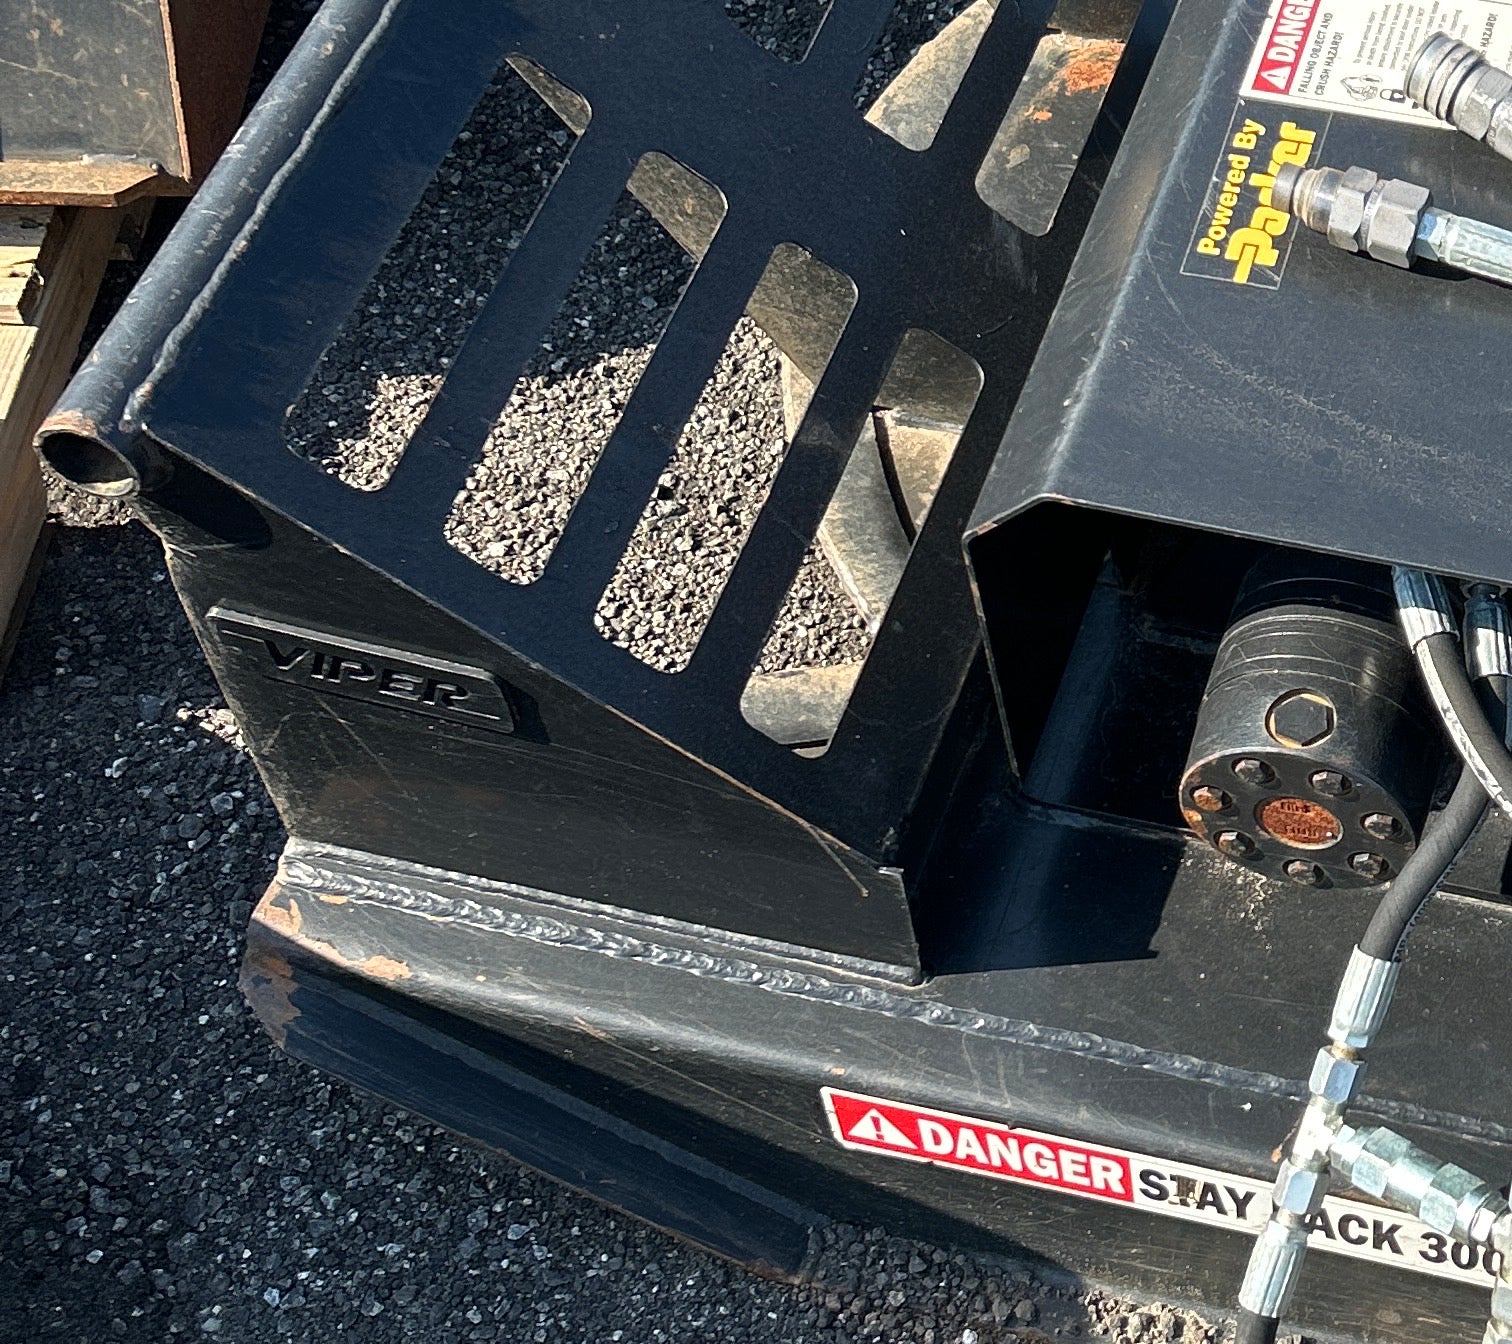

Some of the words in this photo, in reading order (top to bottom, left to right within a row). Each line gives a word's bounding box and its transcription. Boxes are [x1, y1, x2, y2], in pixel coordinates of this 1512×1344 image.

[1296, 59, 1317, 93] FALLING
[1308, 30, 1327, 59] OBJECT
[1319, 12, 1334, 29] AND
[1313, 68, 1331, 95] CRUSH
[1197, 154, 1251, 256] Powered
[1233, 118, 1266, 150] By
[263, 640, 471, 706] VIPER
[917, 1118, 1126, 1194] DANGER
[1272, 1201, 1404, 1256] ACK
